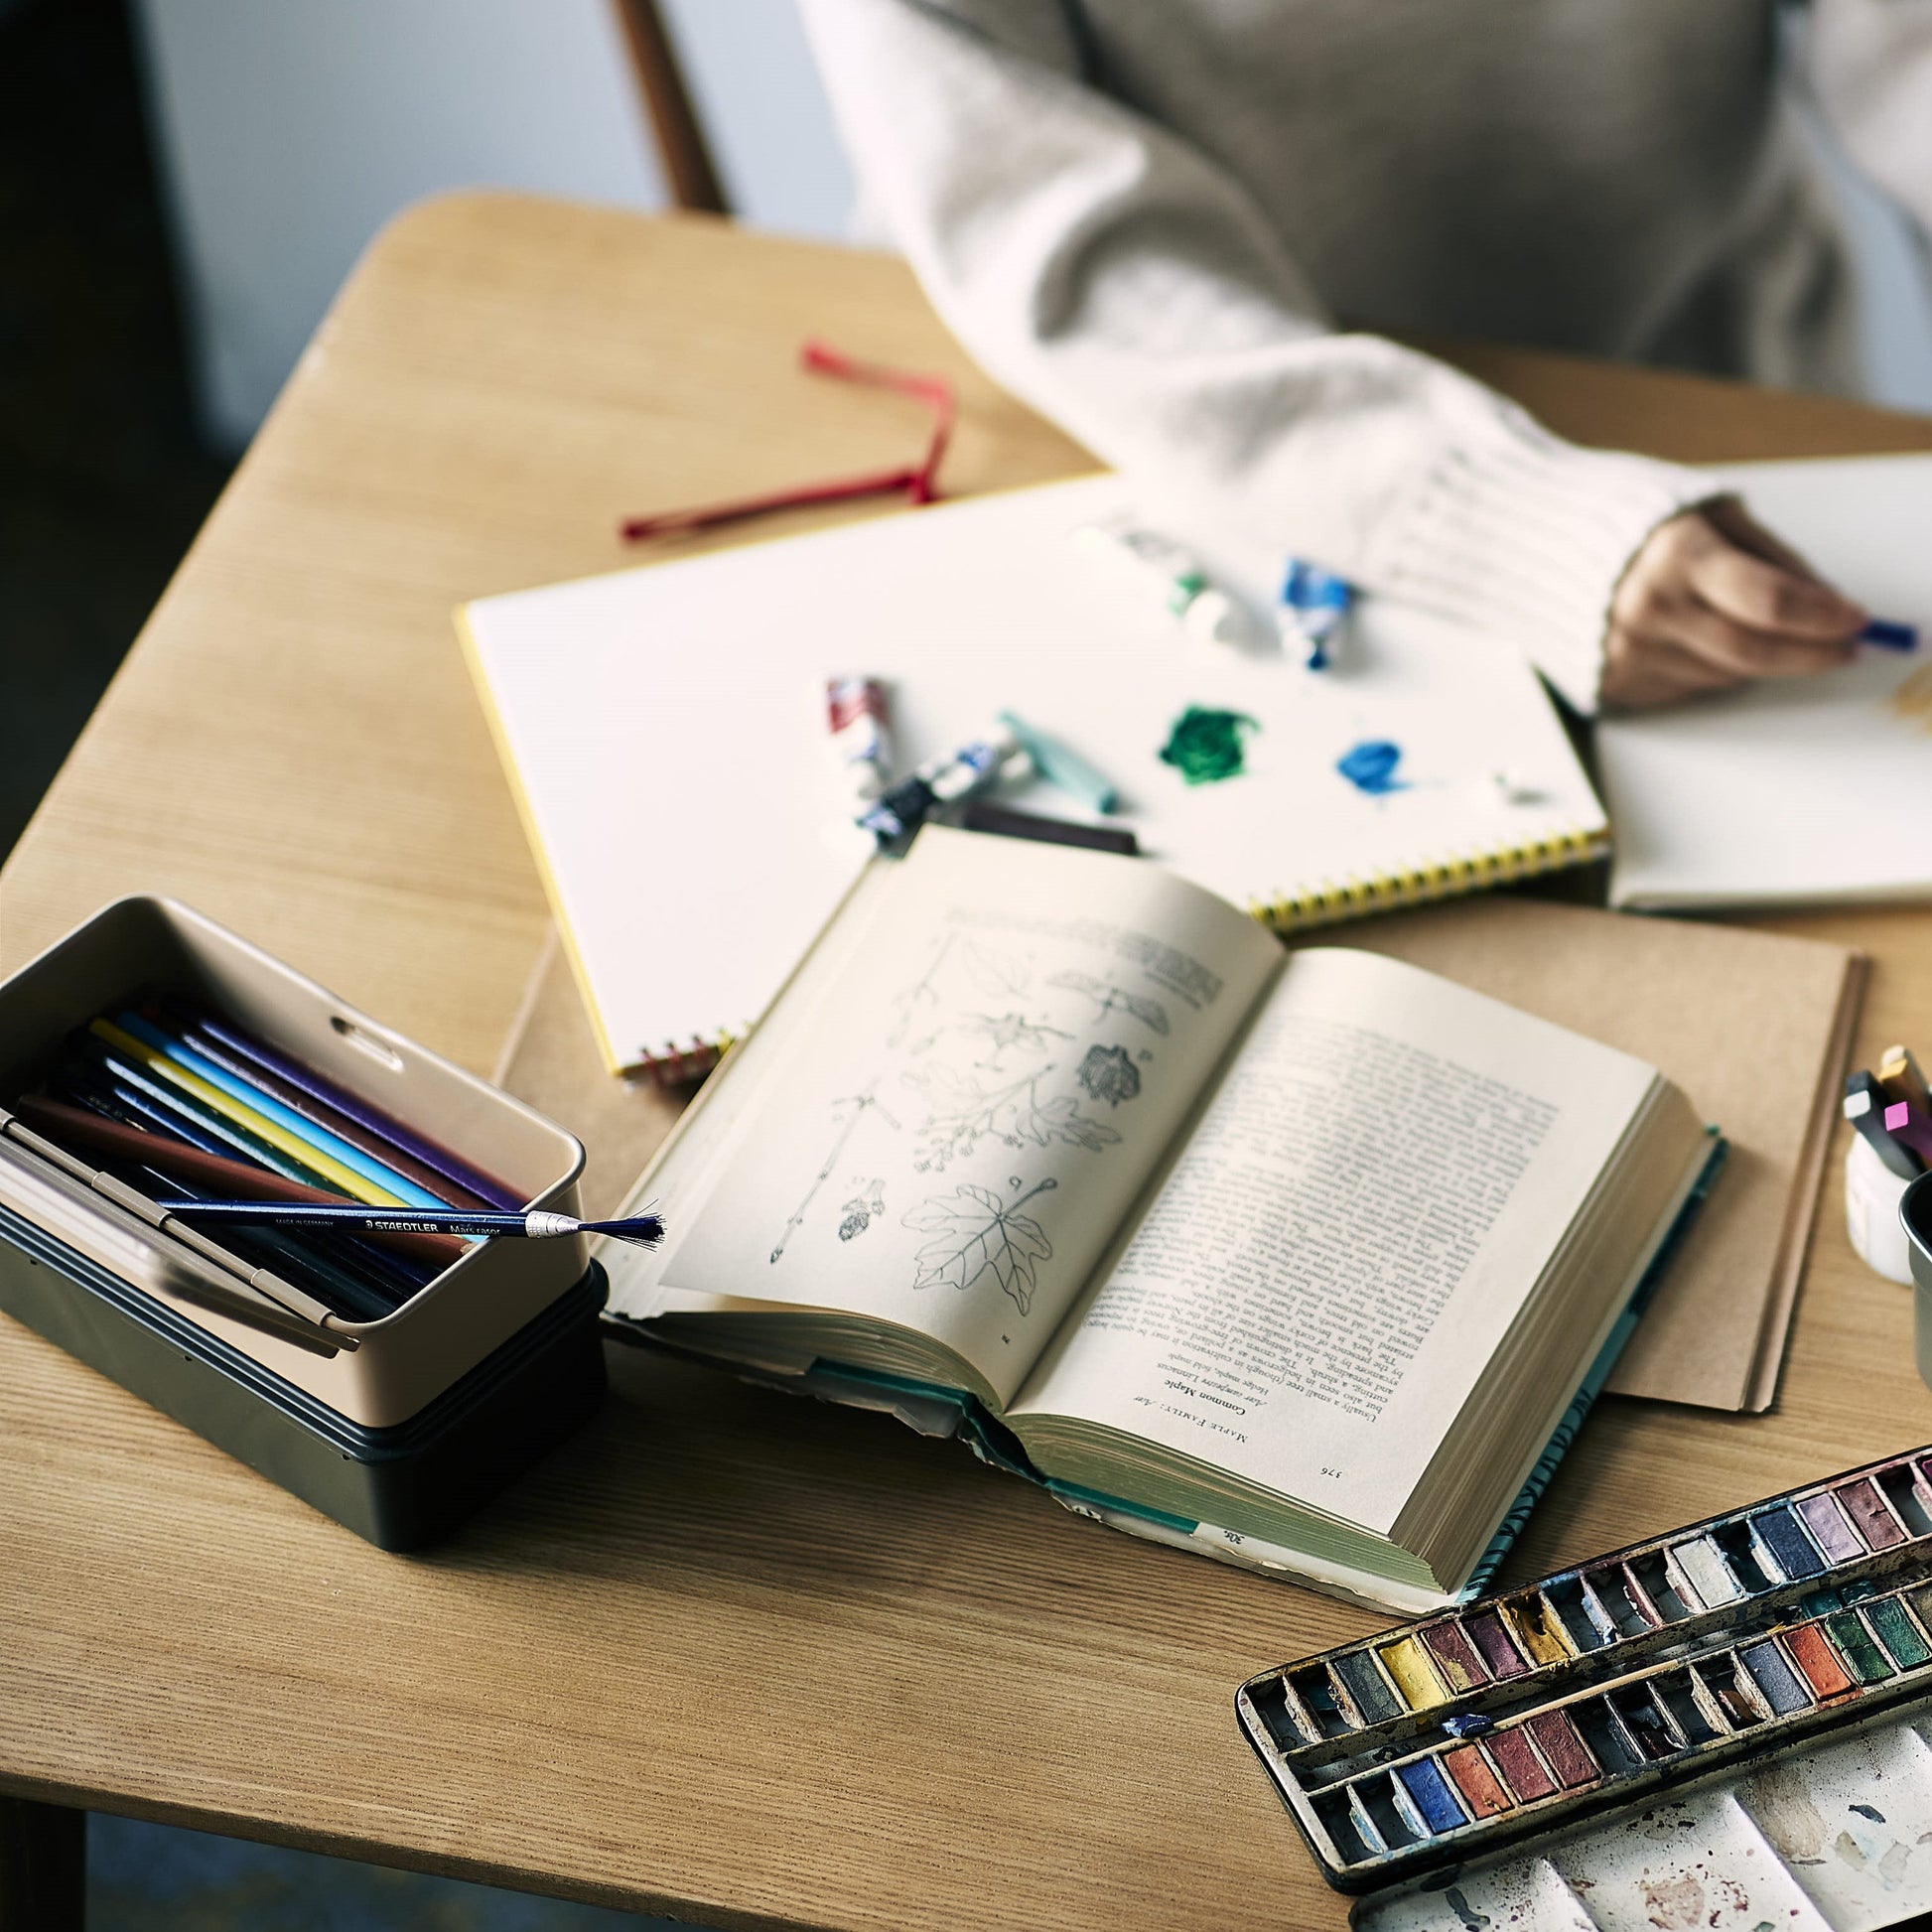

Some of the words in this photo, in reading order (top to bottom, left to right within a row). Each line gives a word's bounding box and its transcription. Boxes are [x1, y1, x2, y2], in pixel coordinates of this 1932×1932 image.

[374, 1221, 439, 1232] STAEDTLER
[1187, 1333, 1225, 1348] pollard
[1227, 1326, 1292, 1357] distinguished
[1229, 1336, 1242, 1346] of
[1291, 1340, 1319, 1353] much
[1315, 1338, 1327, 1348] of
[1180, 1341, 1231, 1362] cultivation
[1245, 1342, 1276, 1357] crown
[1329, 1345, 1372, 1363] presence
[1349, 1342, 1372, 1356] bark
[1278, 1356, 1299, 1369] The
[1294, 1351, 1303, 1361] is
[1304, 1355, 1314, 1366] It
[1321, 1352, 1337, 1363] the
[1377, 1353, 1397, 1366] The
[1233, 1359, 1244, 1370] in
[1250, 1356, 1301, 1383] hedgerows
[1338, 1357, 1351, 1370] by
[1372, 1362, 1388, 1373] the
[1214, 1368, 1239, 1382] maple,
[1243, 1365, 1285, 1386] (though
[1309, 1368, 1337, 1384] shrub.
[1324, 1363, 1372, 1386] spreading.
[1353, 1365, 1398, 1385] sycamore
[1390, 1367, 1403, 1380] by
[1164, 1379, 1195, 1396] Maple
[1242, 1381, 1268, 1395] Hedge
[1285, 1381, 1305, 1393] tree
[1304, 1378, 1314, 1388] in
[1317, 1384, 1339, 1395] seen
[1372, 1384, 1393, 1395] and
[1304, 1390, 1331, 1402] small
[1341, 1394, 1361, 1405] also
[1351, 1384, 1387, 1403] cutting,
[1133, 1395, 1156, 1408] Acer
[1198, 1392, 1246, 1415] Common
[1243, 1395, 1267, 1408] Acer
[1340, 1401, 1377, 1423] Usually
[1363, 1403, 1382, 1414] but
[1209, 1423, 1248, 1442] MAPLE
[1319, 1466, 1341, 1477] 376
